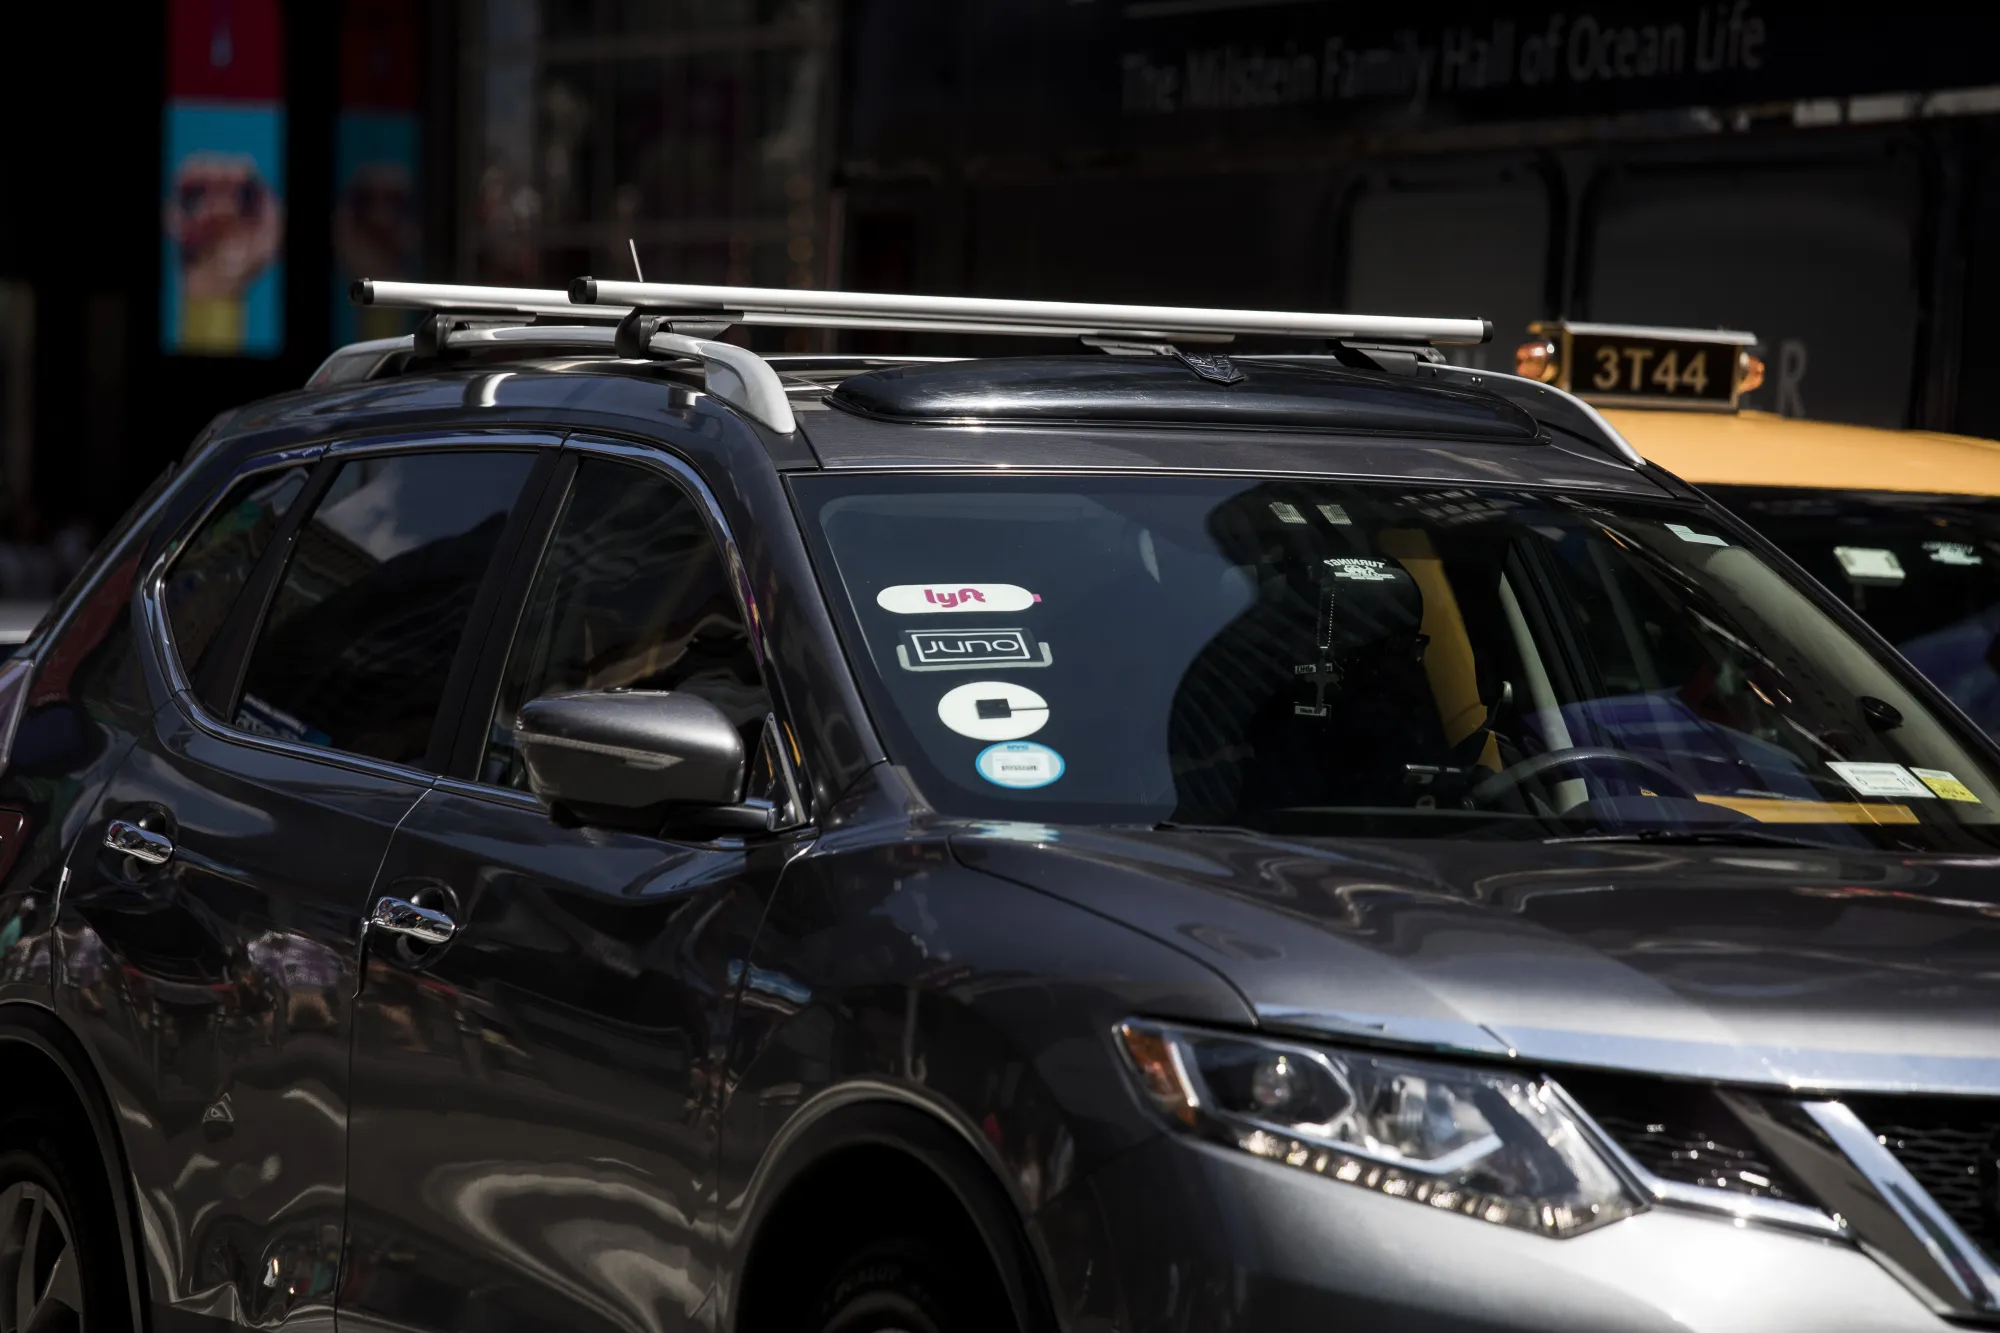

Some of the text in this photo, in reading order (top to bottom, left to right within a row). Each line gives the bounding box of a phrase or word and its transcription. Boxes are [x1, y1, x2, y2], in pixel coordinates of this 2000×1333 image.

[1121, 51, 1178, 114] The
[1323, 28, 1435, 117] Family
[1441, 19, 1516, 90] Hall
[1520, 13, 1565, 85] of
[1567, 13, 1686, 82] Ocean
[1696, 1, 1766, 73] Life
[1593, 344, 1710, 394] 3T44
[924, 588, 986, 608] lyft
